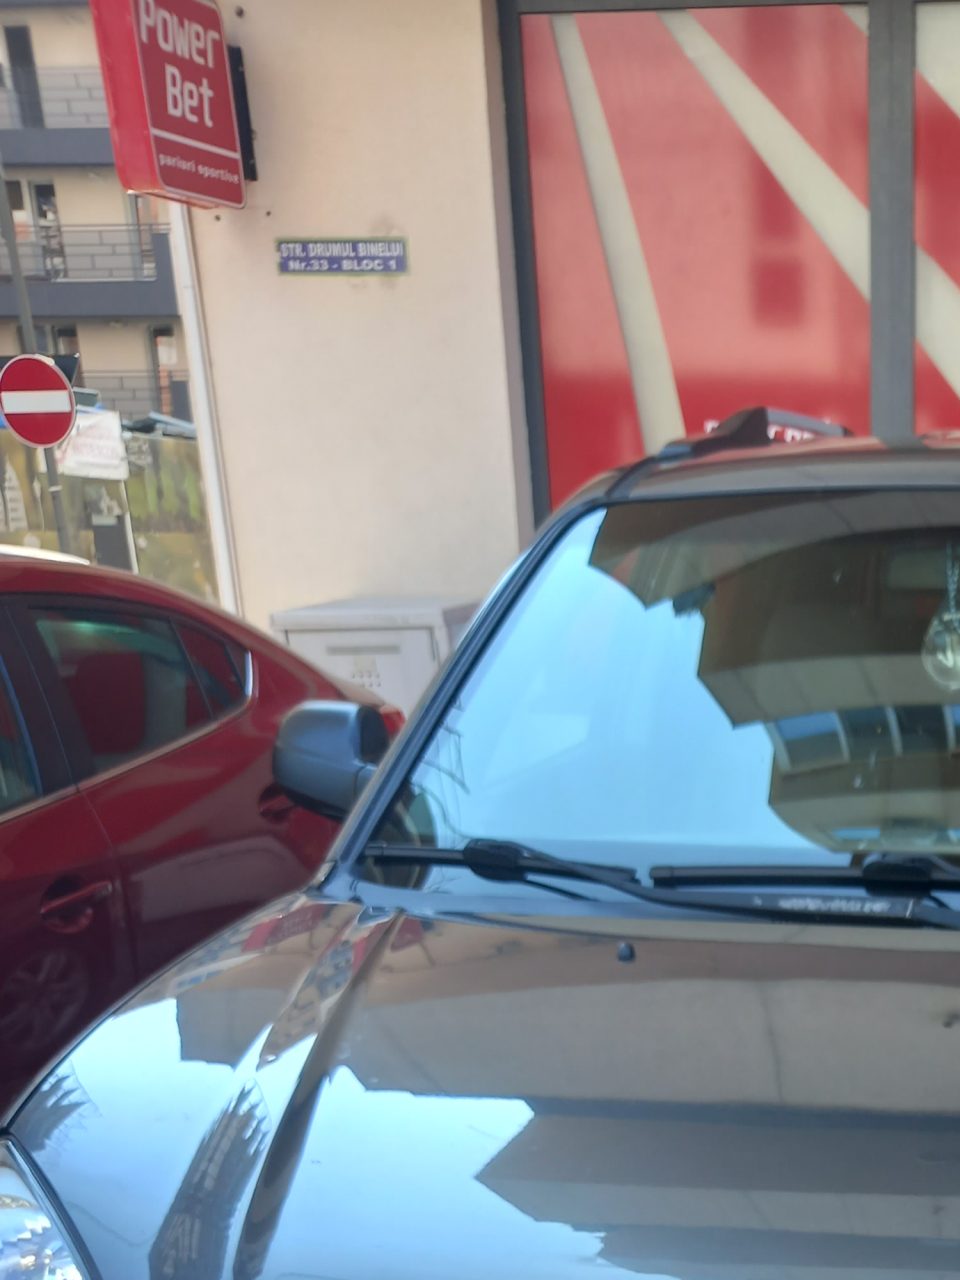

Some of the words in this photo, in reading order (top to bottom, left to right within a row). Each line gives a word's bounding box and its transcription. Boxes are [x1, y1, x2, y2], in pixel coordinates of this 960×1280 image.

[138, 0, 220, 69] Power
[164, 62, 215, 129] Bet
[308, 242, 356, 257] DRUMUL
[341, 259, 385, 271] BLOC
